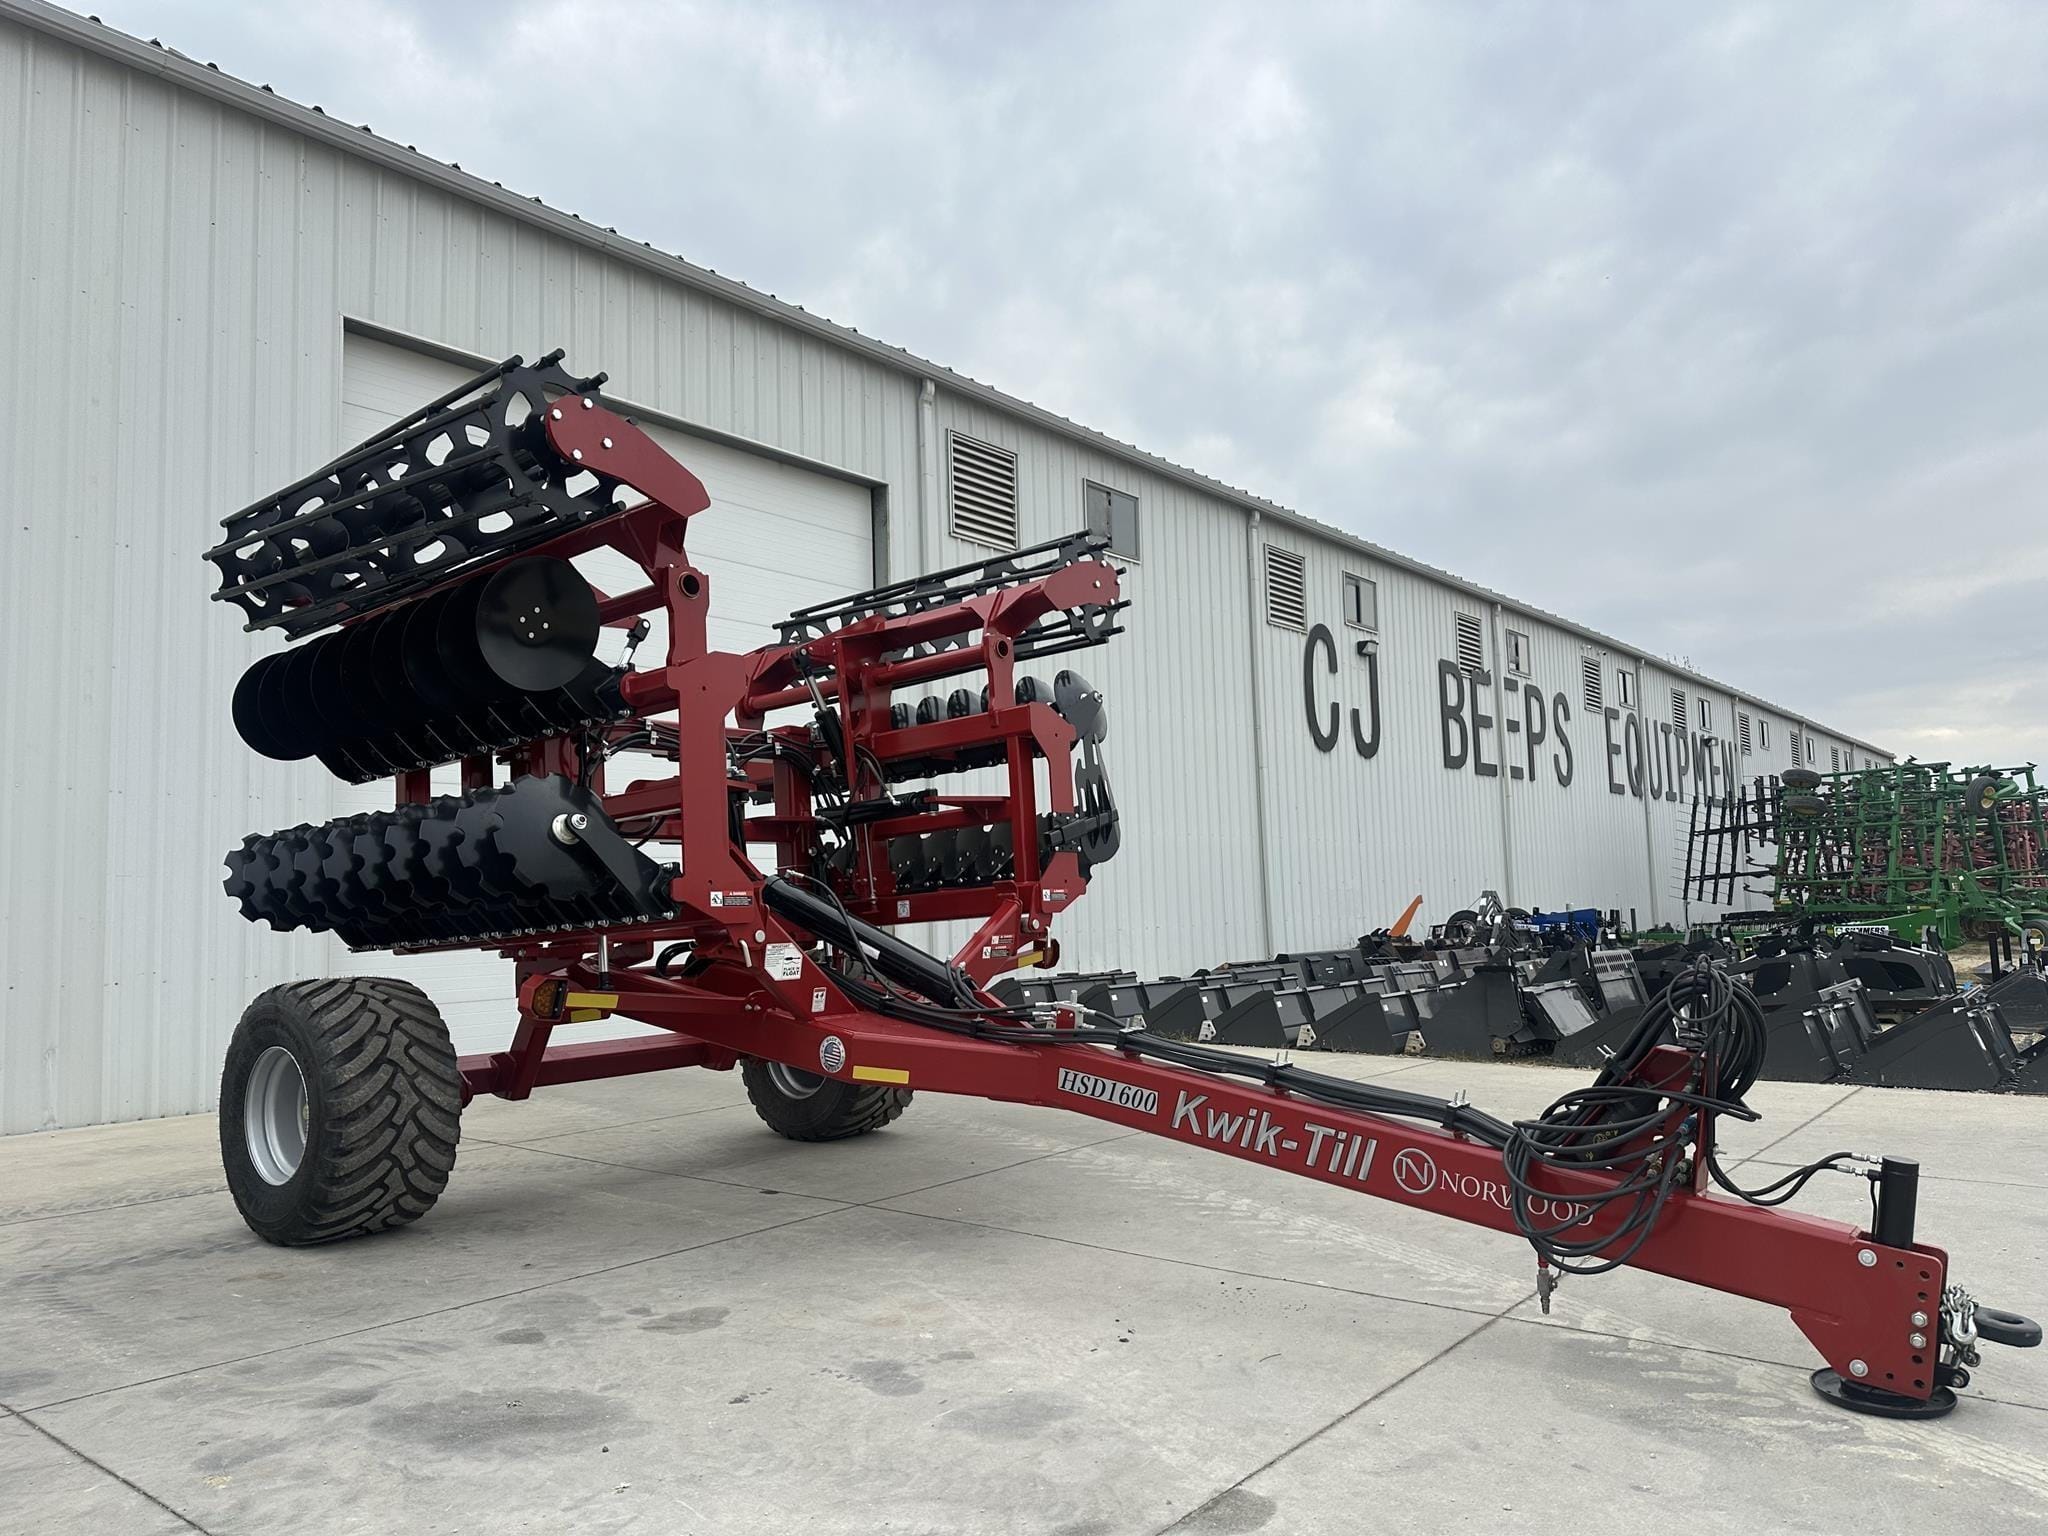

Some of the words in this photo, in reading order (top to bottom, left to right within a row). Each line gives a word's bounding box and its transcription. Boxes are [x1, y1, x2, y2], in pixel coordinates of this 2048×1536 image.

[1304, 624, 1380, 759] CJ
[1604, 707, 1741, 808] EQUIPMEN
[1059, 1070, 1157, 1112] HSD1600
[1170, 1090, 1379, 1182] Kwik-Till
